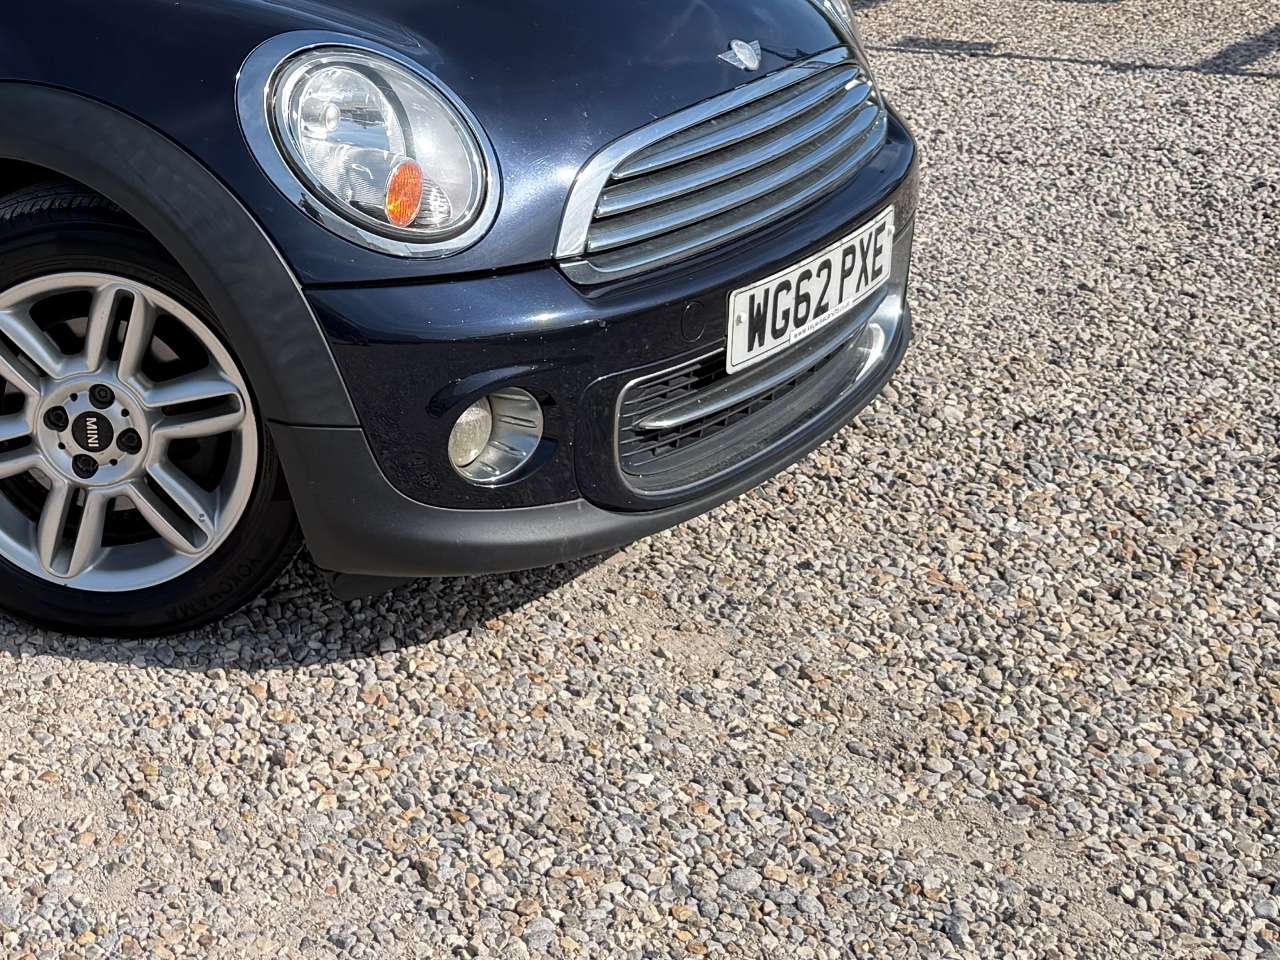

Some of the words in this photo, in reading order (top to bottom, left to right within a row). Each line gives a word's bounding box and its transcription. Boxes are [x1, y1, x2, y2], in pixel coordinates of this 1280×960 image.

[747, 259, 833, 353] WG62
[837, 220, 887, 305] PXE
[86, 417, 100, 447] MINI
